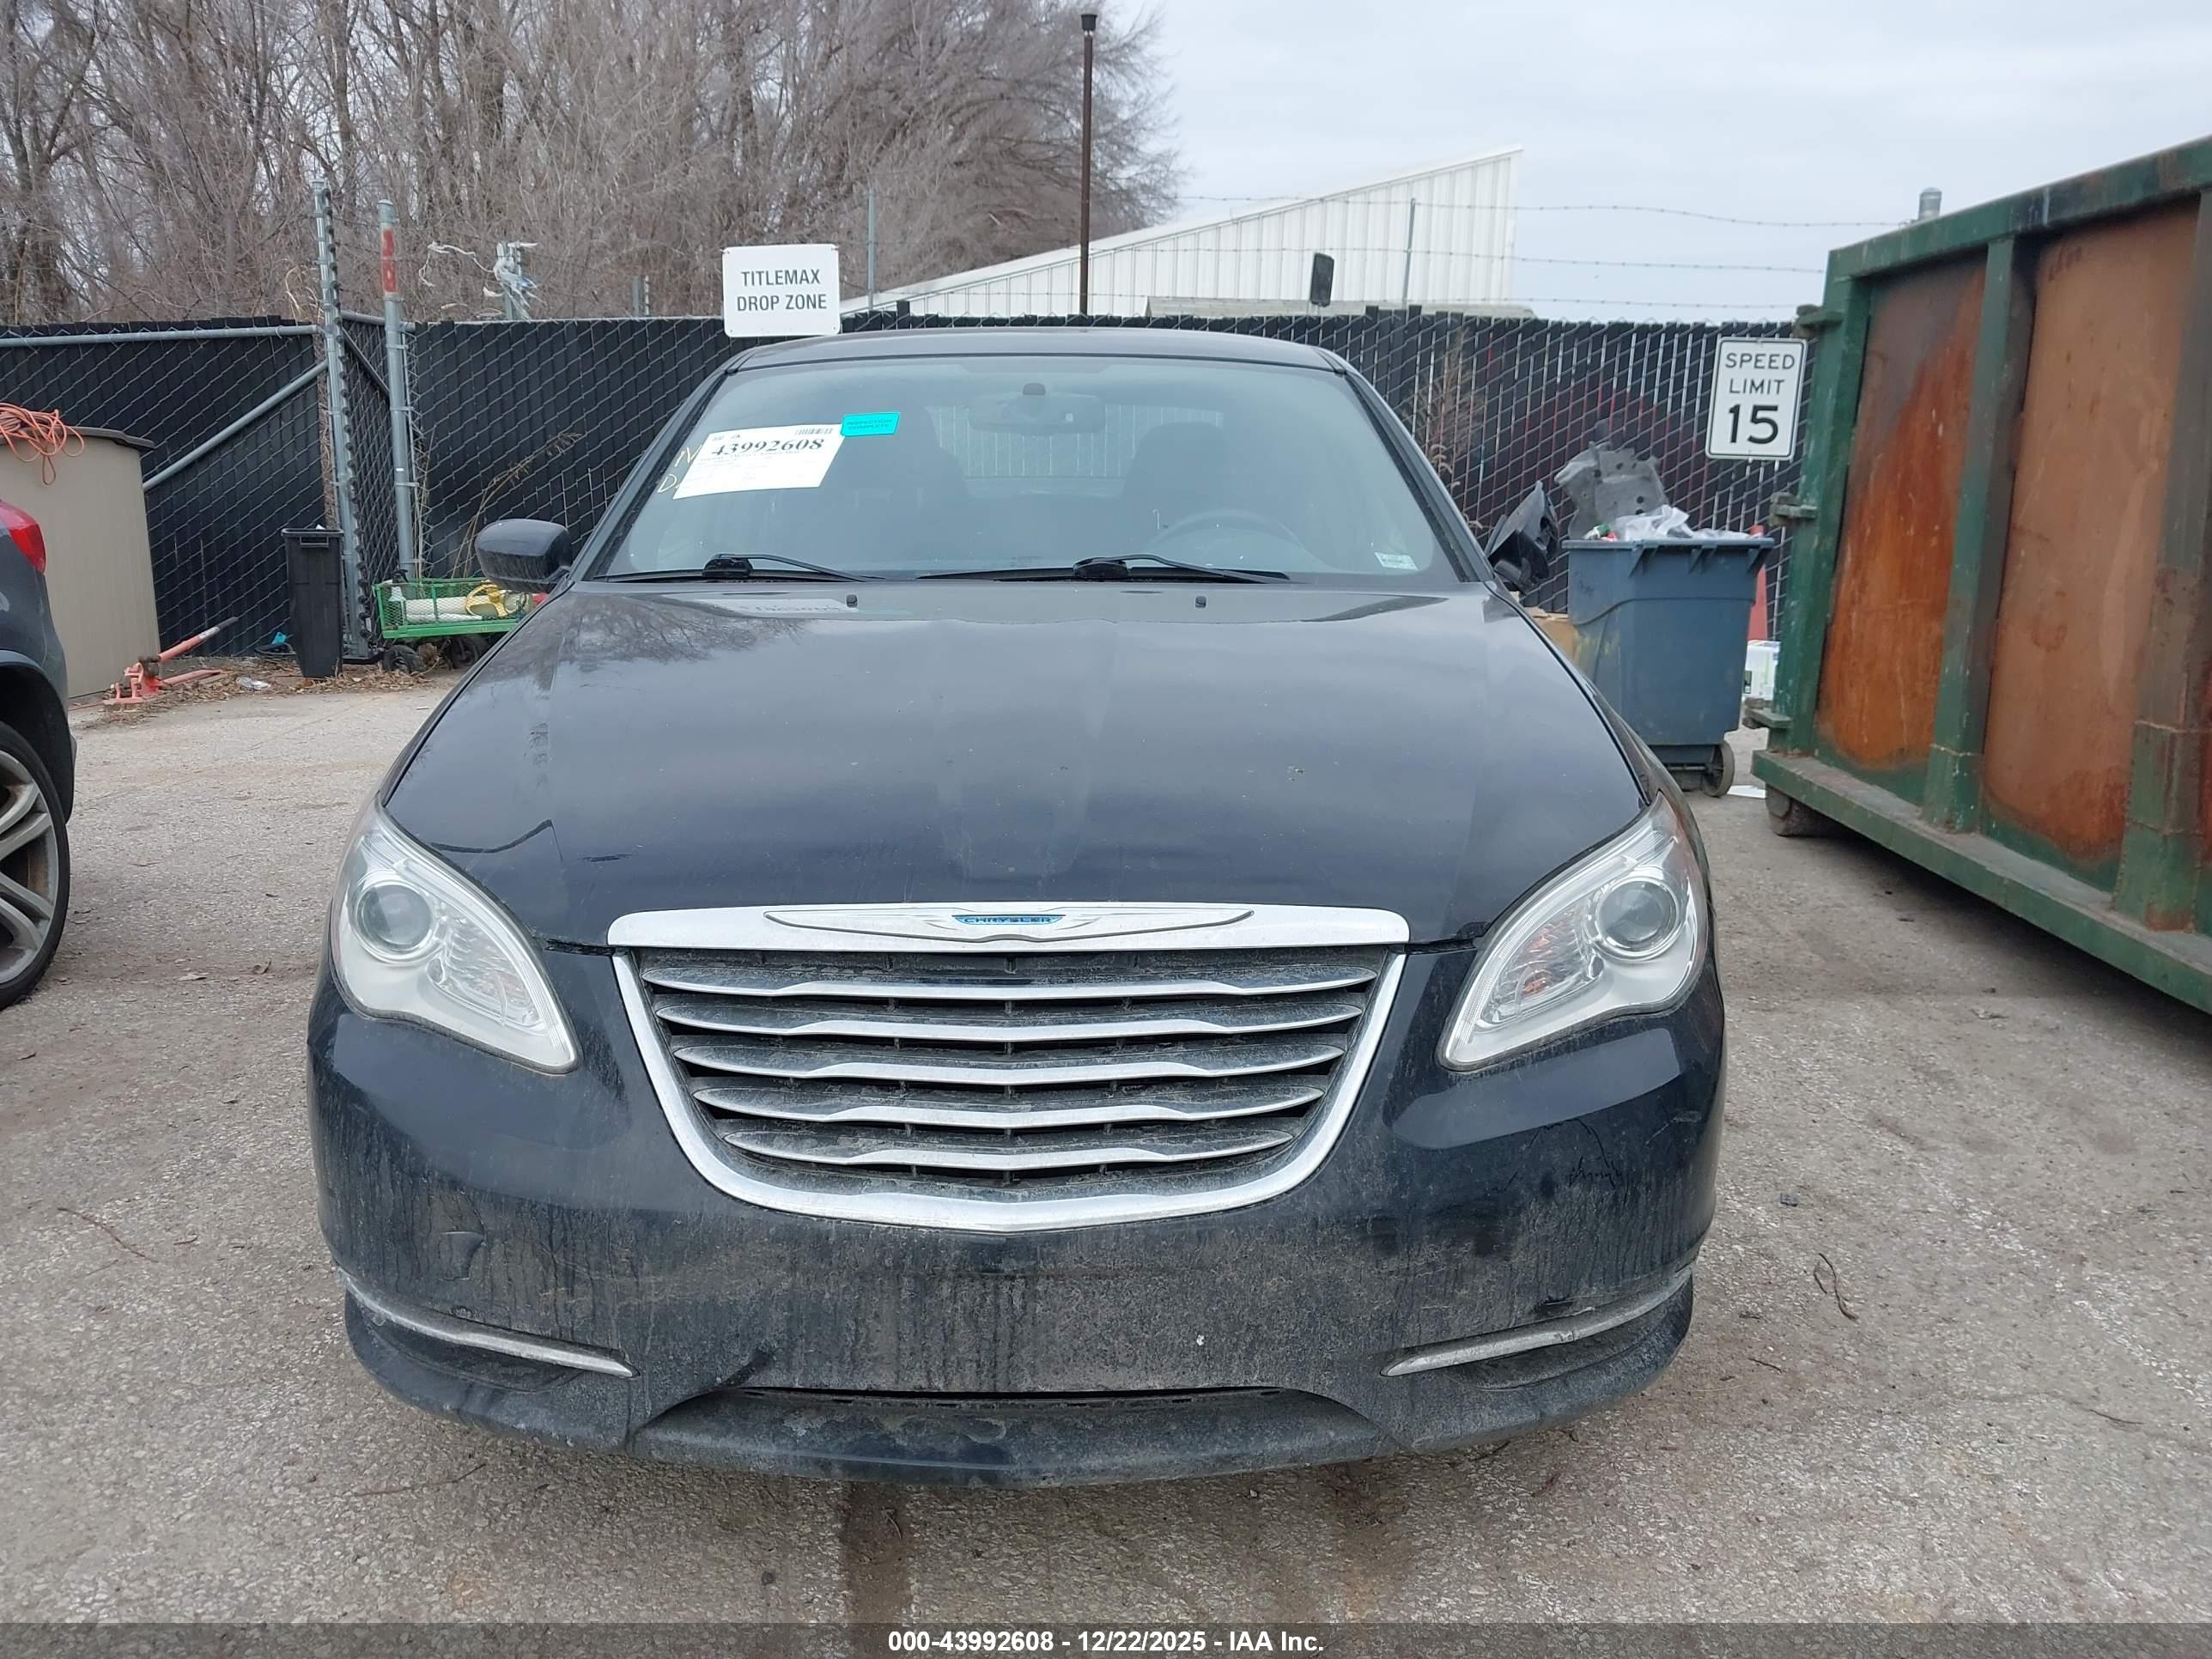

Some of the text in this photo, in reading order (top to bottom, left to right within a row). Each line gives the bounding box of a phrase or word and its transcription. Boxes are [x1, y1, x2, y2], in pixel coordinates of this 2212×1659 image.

[741, 269, 821, 287] TITLEMAX
[737, 294, 828, 312] DROP ZONE
[1724, 352, 1796, 370] SPEED
[1729, 378, 1786, 395] LIMIT
[1728, 404, 1779, 445] 15
[711, 438, 825, 456] 43992608
